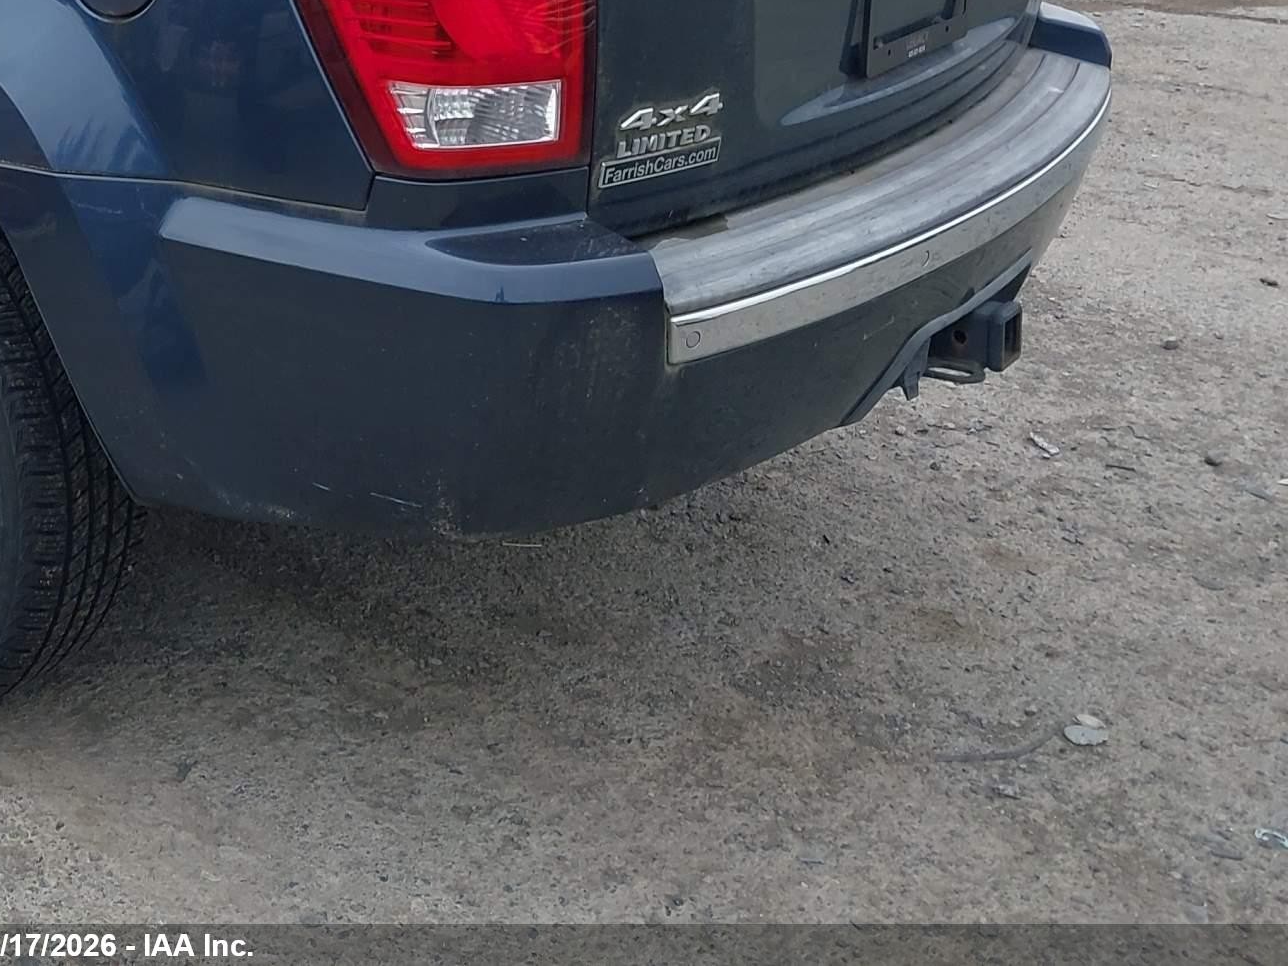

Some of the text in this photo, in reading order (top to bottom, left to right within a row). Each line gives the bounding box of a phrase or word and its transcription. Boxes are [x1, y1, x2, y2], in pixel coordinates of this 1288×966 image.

[620, 92, 723, 130] 4x4
[617, 124, 712, 158] LIMITED
[604, 146, 717, 184] FarrishCars.com
